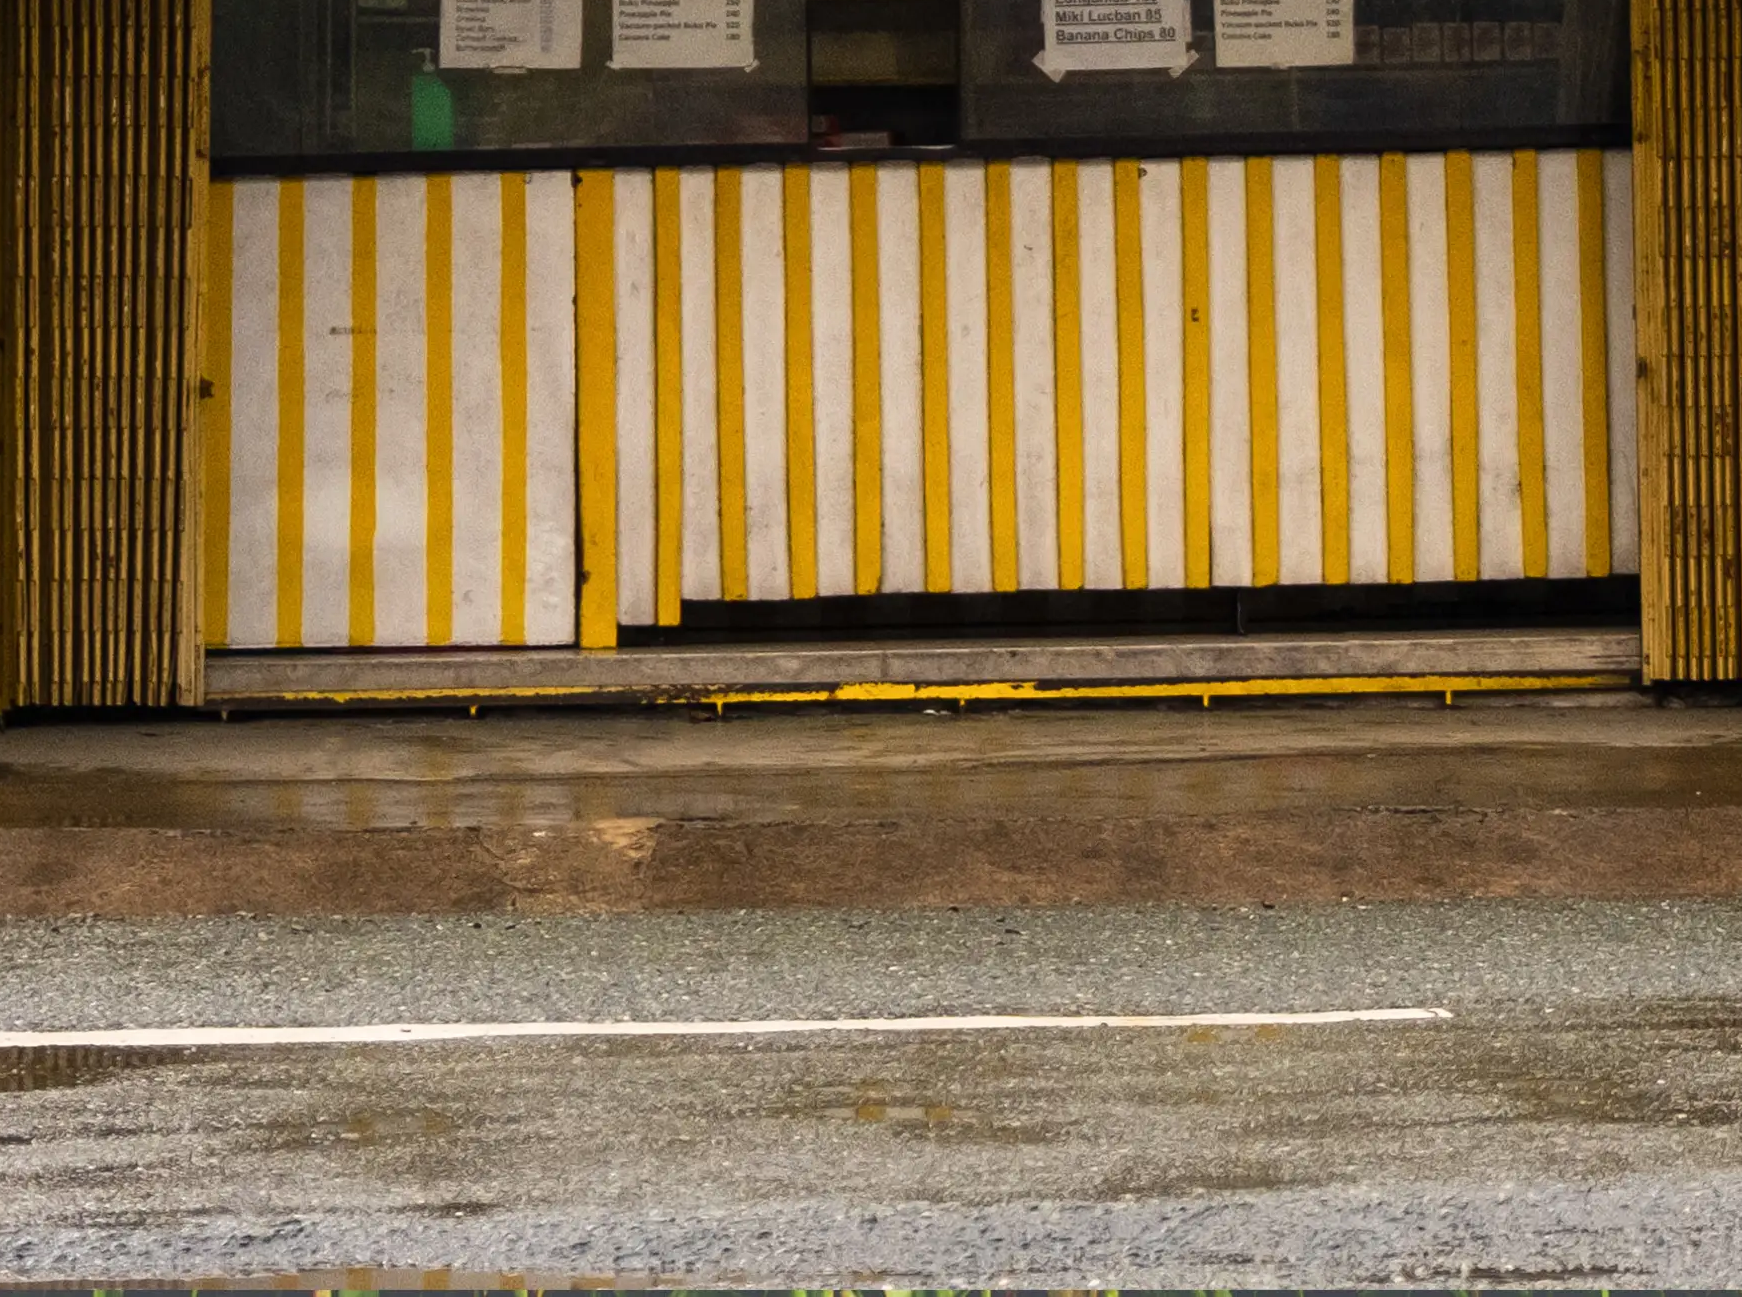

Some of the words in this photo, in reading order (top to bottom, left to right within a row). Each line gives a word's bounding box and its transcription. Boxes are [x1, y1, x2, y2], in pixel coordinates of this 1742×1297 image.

[1056, 9, 1084, 22] Miki
[1089, 9, 1141, 22] Lucban
[1056, 28, 1109, 41] Banana
[1114, 28, 1154, 41] Chips
